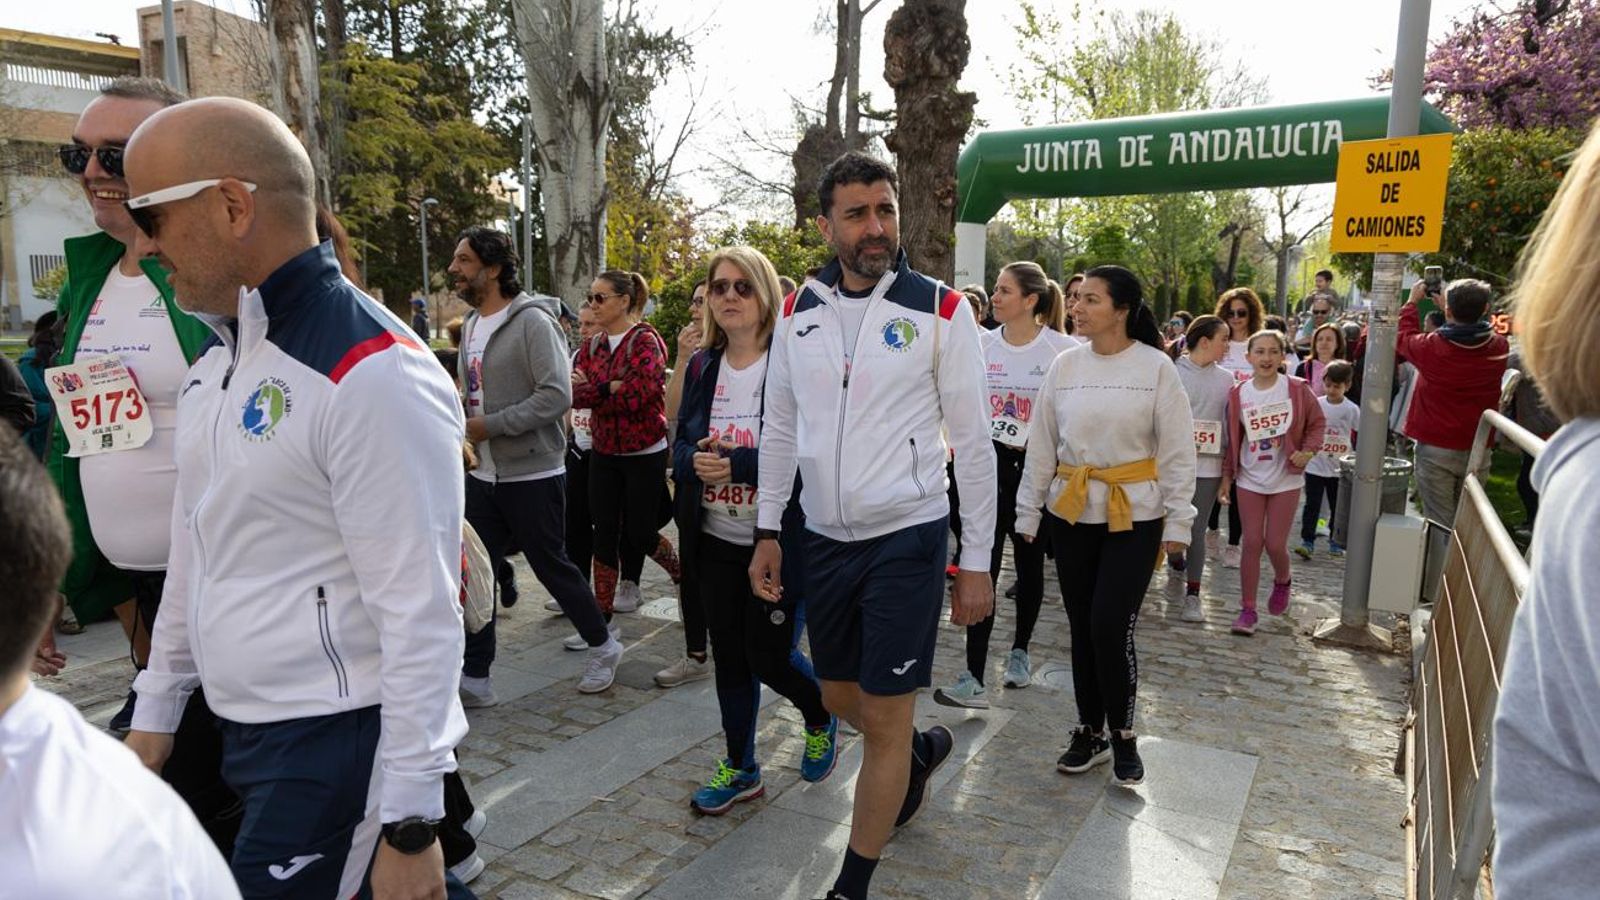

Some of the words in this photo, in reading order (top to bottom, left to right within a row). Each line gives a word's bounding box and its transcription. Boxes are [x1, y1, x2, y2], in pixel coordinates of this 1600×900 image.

[1016, 139, 1103, 173] JUNTA
[1118, 134, 1154, 168] DE
[1168, 119, 1343, 165] ANDALUCIA
[1366, 149, 1420, 174] SALIDA
[1381, 183, 1400, 203] DE
[1346, 216, 1425, 238] CAMIONES
[70, 387, 144, 430] 5173
[991, 420, 1019, 437] 36
[1250, 411, 1289, 431] 5557
[704, 485, 757, 505] 5487
